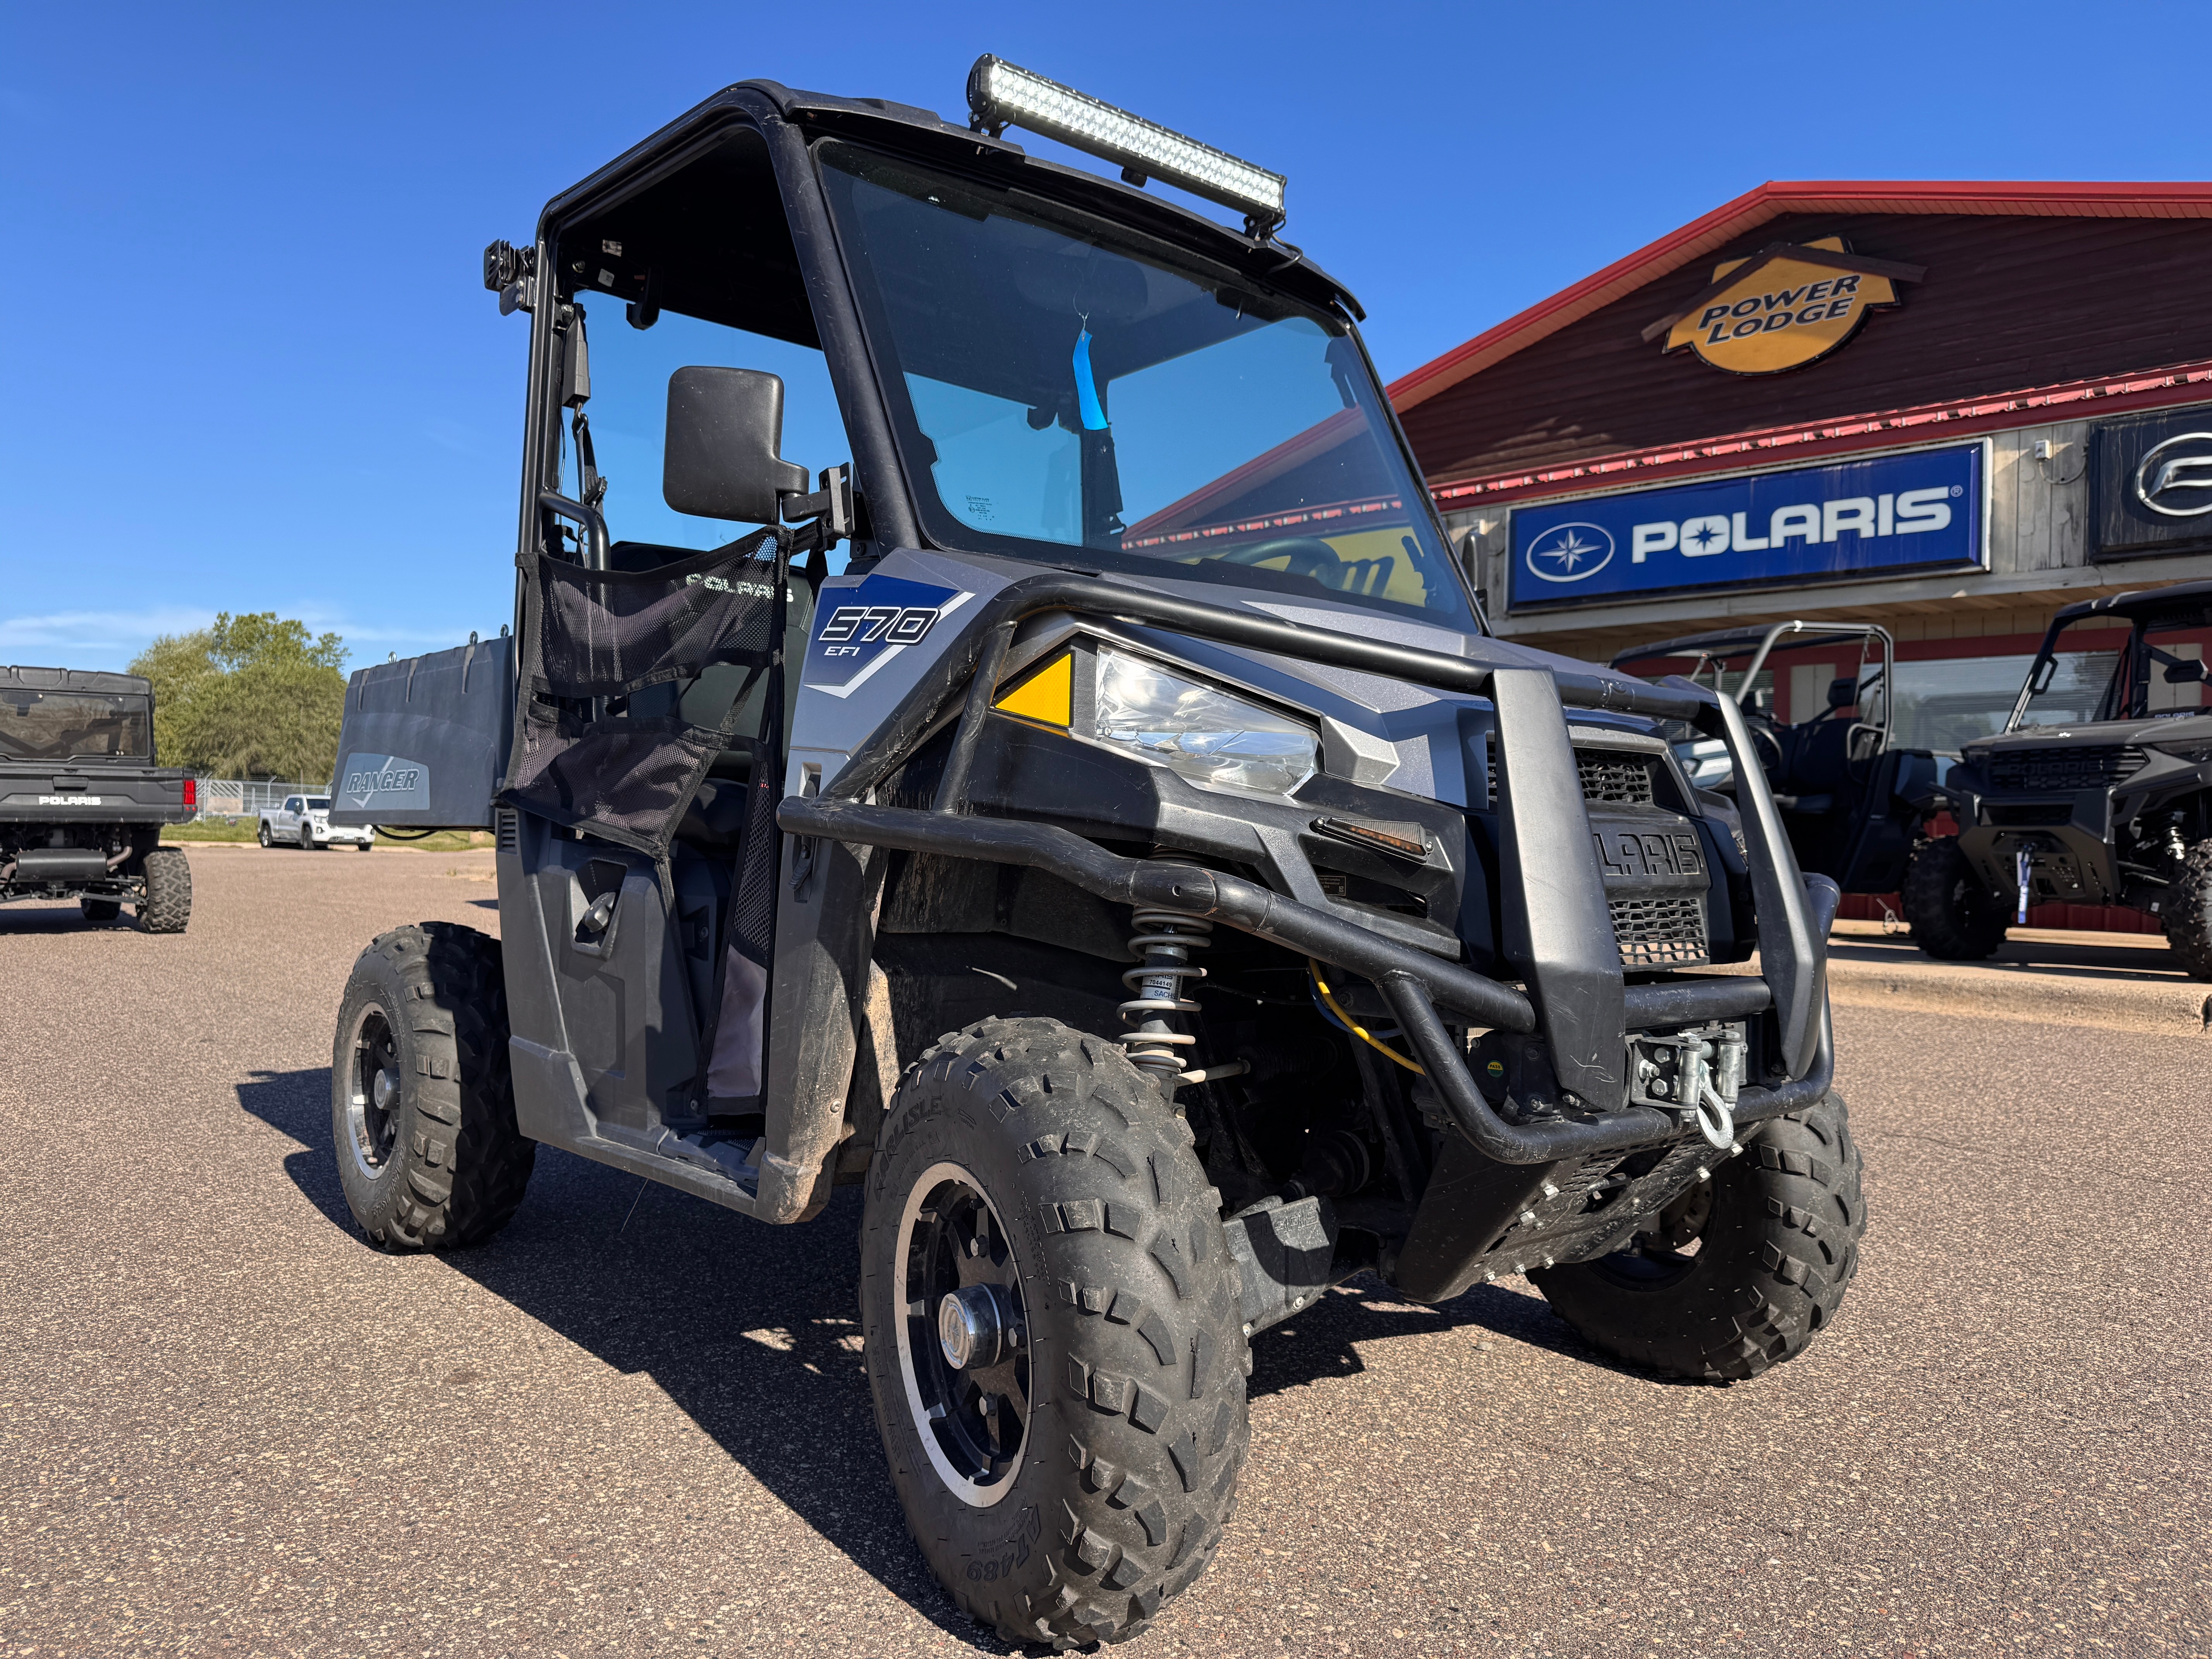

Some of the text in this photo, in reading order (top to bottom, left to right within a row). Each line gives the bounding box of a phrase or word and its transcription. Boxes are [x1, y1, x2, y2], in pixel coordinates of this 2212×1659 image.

[1697, 275, 1861, 330] POWER
[1705, 296, 1855, 346] LODGE
[1632, 486, 1951, 564] POLARIS
[818, 606, 939, 644] 570
[824, 646, 860, 656] EFI
[347, 769, 419, 793] RANGER
[39, 796, 101, 805] POLARIS
[1593, 833, 1703, 876] LARIS
[1154, 990, 1176, 999] SACHS
